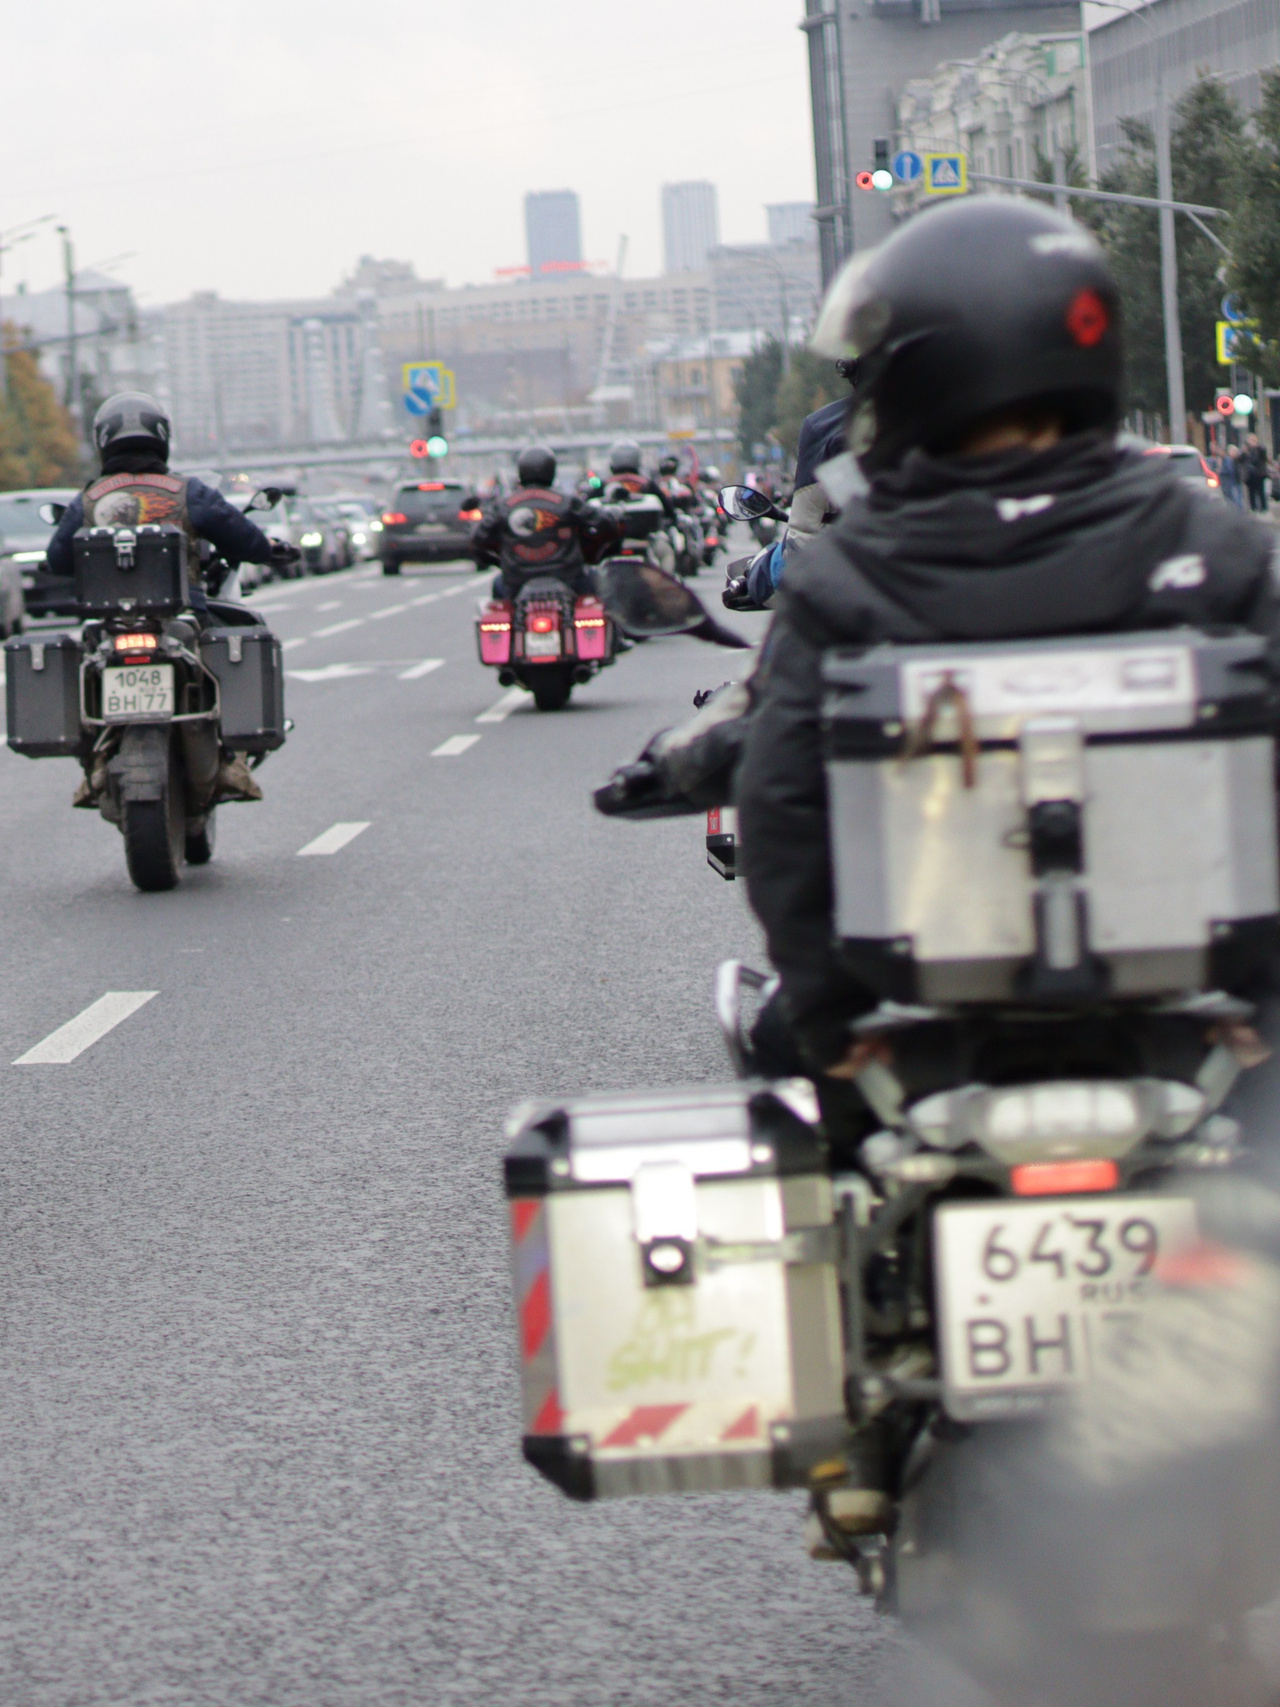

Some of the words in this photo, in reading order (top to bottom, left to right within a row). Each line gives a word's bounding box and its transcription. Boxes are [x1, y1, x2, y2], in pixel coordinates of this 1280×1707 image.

[115, 670, 161, 688] 1048
[144, 693, 167, 710] 77
[981, 1217, 1159, 1281] 6439
